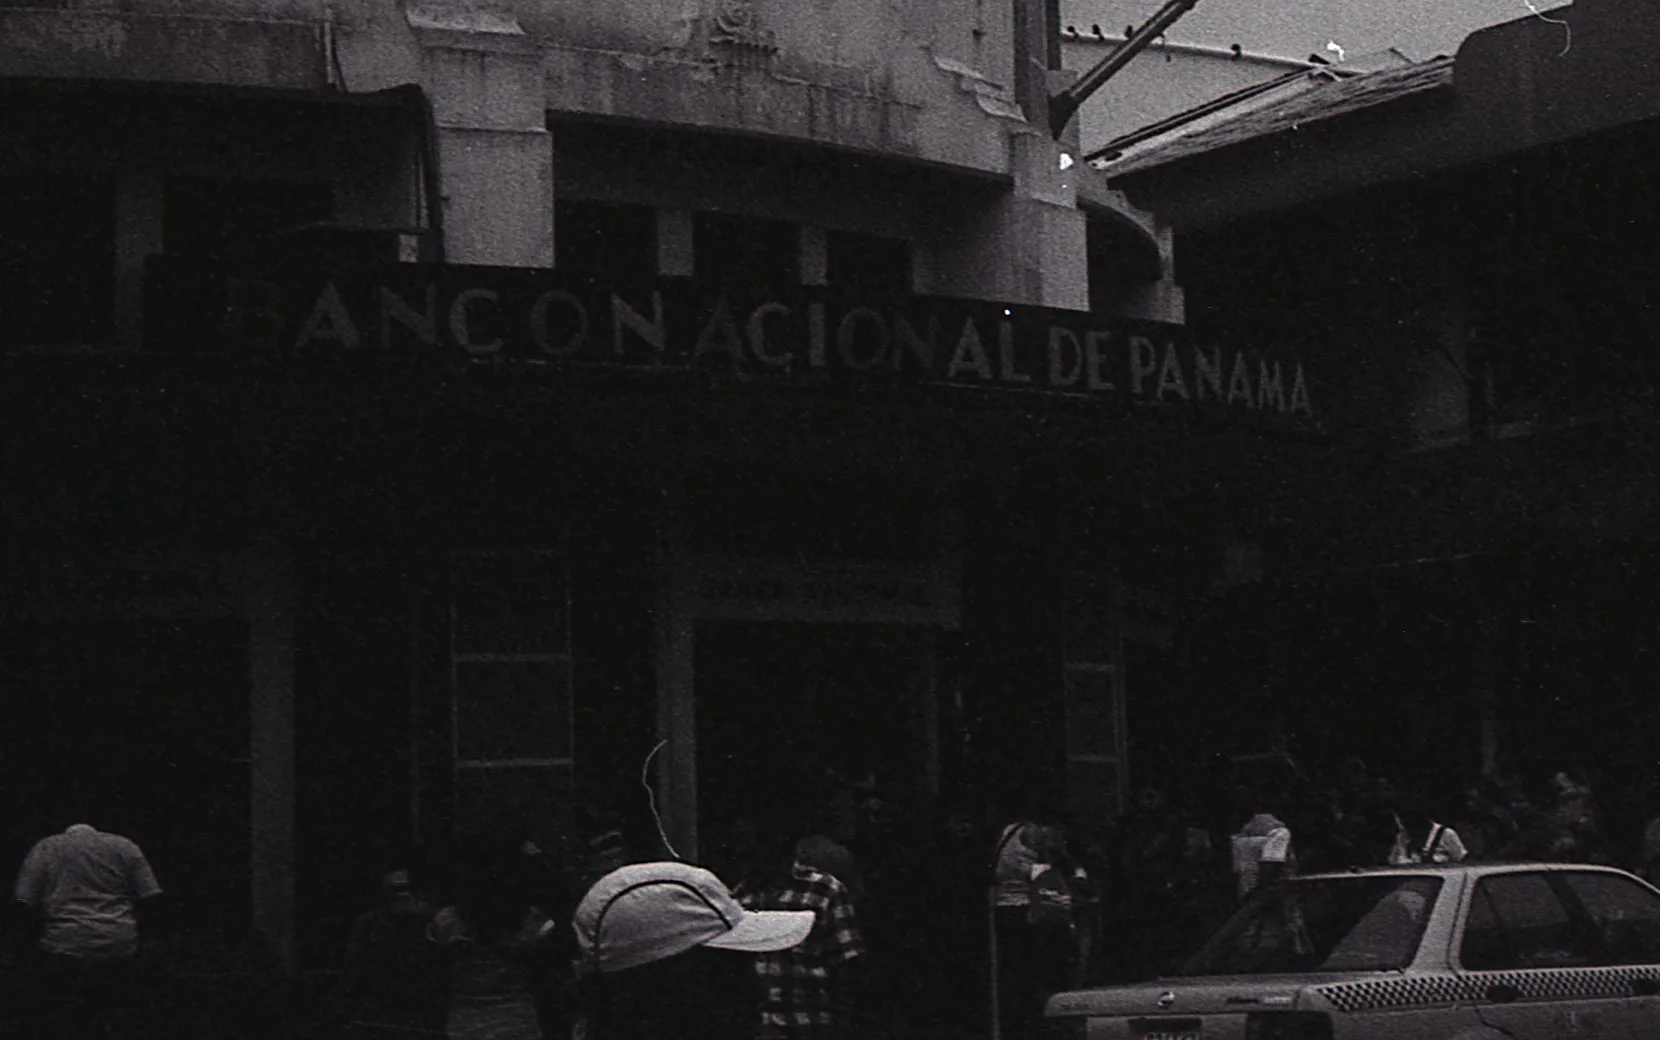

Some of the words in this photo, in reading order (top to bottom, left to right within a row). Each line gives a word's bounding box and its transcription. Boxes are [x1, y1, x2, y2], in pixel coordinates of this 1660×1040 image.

[221, 278, 589, 357] BANCO
[610, 289, 1033, 384] NACIONAL
[1048, 324, 1116, 391] DE
[1129, 335, 1314, 419] PANAMA
